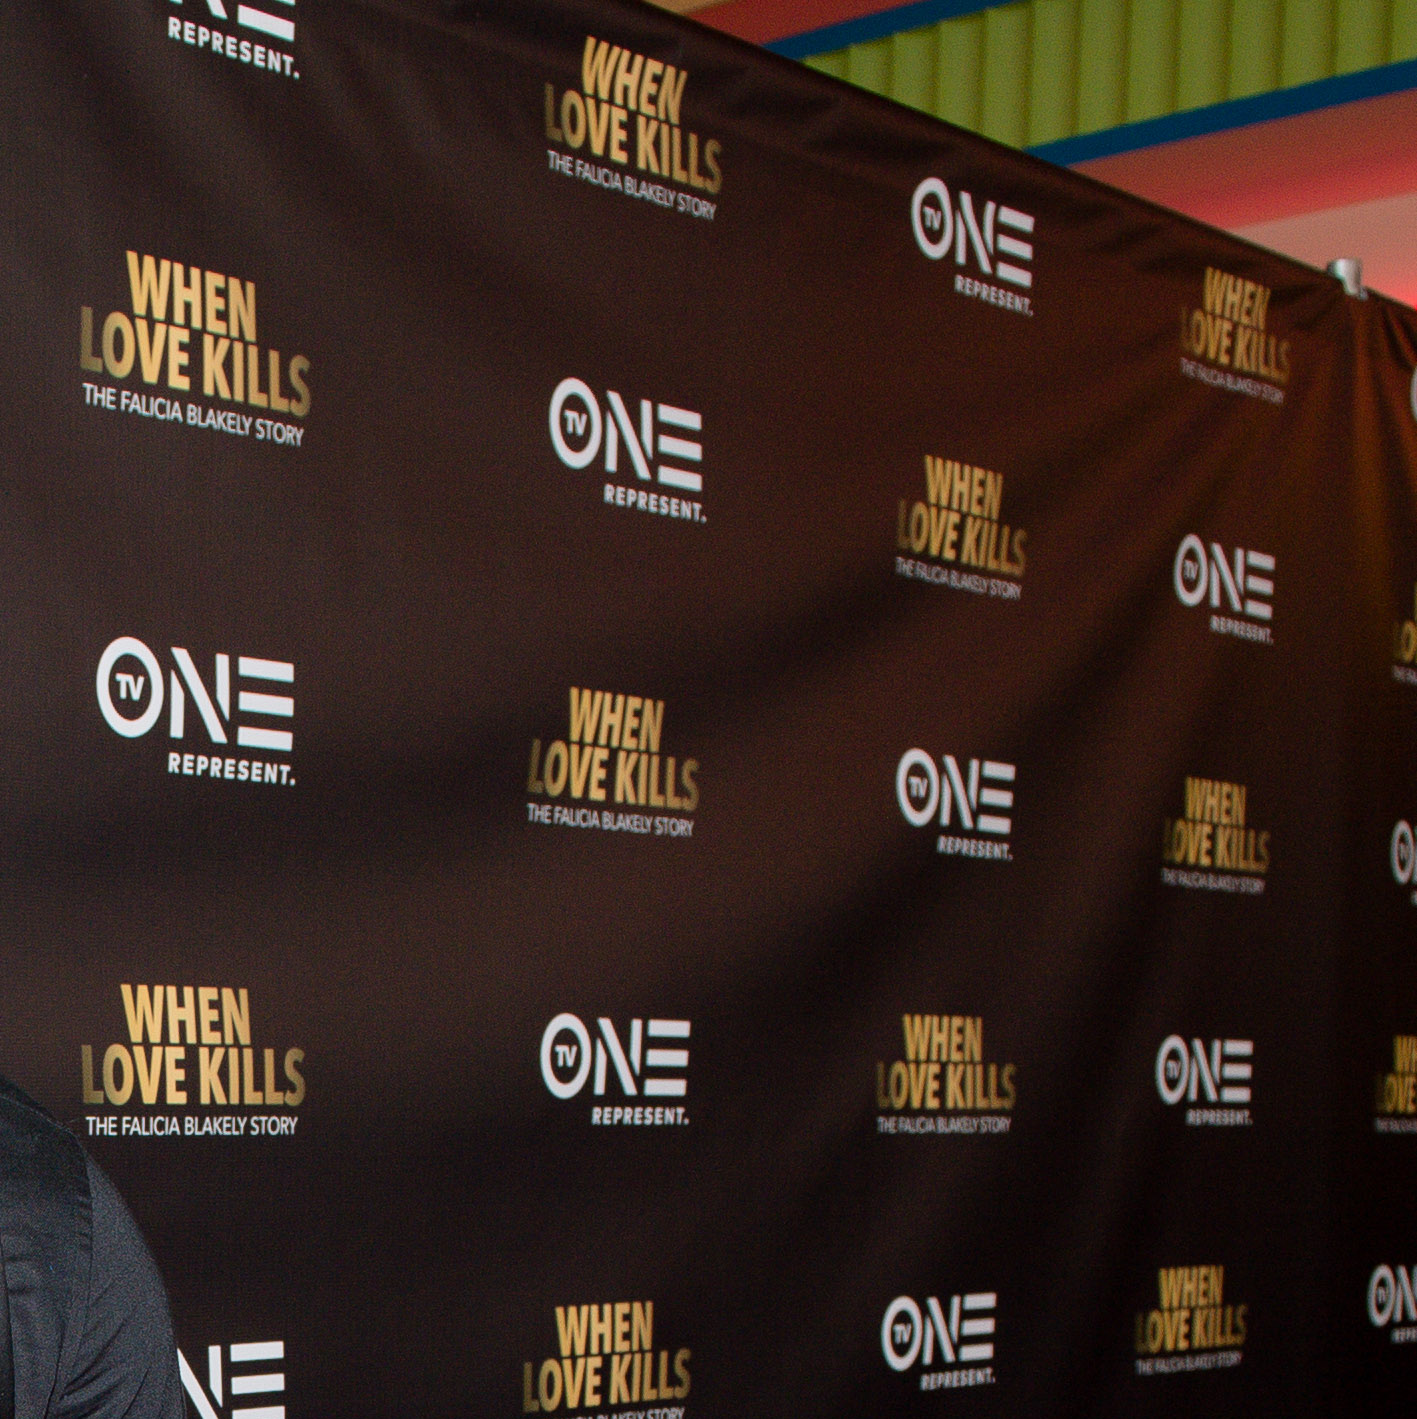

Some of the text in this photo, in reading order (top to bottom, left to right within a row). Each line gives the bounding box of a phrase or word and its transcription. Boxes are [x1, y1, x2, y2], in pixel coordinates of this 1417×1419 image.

[168, 16, 300, 80] REPRESENT.
[582, 35, 683, 125] WHEN
[546, 83, 723, 194] LOVE KILLS
[913, 177, 1033, 287] ONE
[127, 249, 256, 342] WHEN
[80, 304, 310, 416] LOVE KILLS
[83, 382, 304, 446] THE FALICIA BLAKELY STORY
[550, 378, 701, 490] ONE
[606, 484, 705, 522] REPRESENT.
[929, 453, 1002, 521] WHEN
[897, 498, 1027, 576] LOVE KILLS
[1175, 535, 1275, 617] ONE
[97, 636, 294, 750] ONE
[116, 673, 144, 700] TV
[570, 688, 663, 752] WHEN
[169, 752, 295, 784] REPRESENT.
[528, 738, 699, 811] LOVE KILLS
[898, 746, 1015, 832] ONE
[122, 982, 250, 1045] WHEN
[905, 1015, 982, 1061] WHEN
[81, 1043, 305, 1106] LOVE KILLS
[541, 1012, 690, 1098] ONE
[877, 1061, 1016, 1110] LOVE KILLS
[1157, 1036, 1252, 1102] ONE
[86, 1115, 299, 1135] THE FALICIA BLAKELY STORY
[593, 1107, 687, 1124] REPRESENT.
[557, 1300, 653, 1357] WHEN
[883, 1293, 996, 1370] ONE
[523, 1348, 691, 1412] LOVE KILLS
